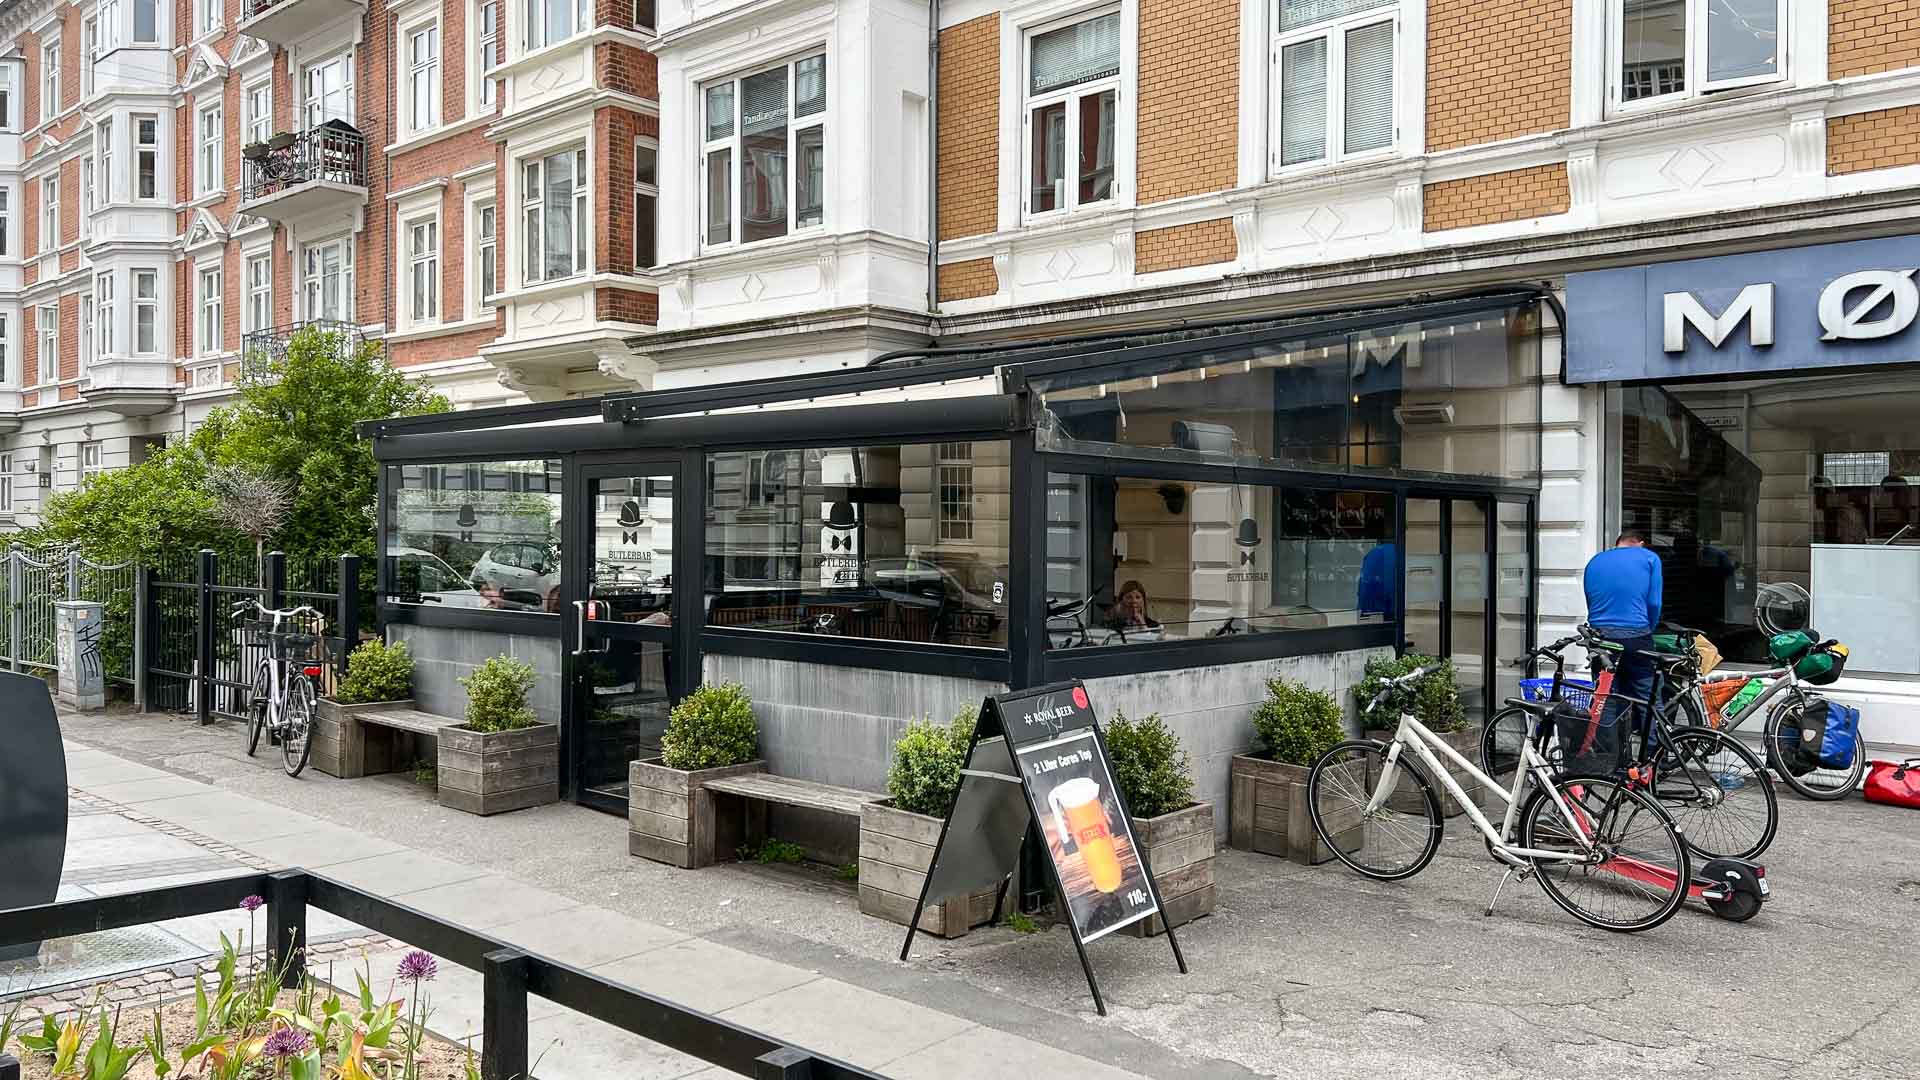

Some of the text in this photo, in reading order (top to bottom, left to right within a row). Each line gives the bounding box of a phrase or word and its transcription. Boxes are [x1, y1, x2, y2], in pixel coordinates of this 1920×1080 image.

[608, 550, 652, 561] BUTLERBAR
[1033, 705, 1075, 723] ROYAL BEER
[1033, 762, 1042, 775] 2
[1077, 749, 1093, 762] Top
